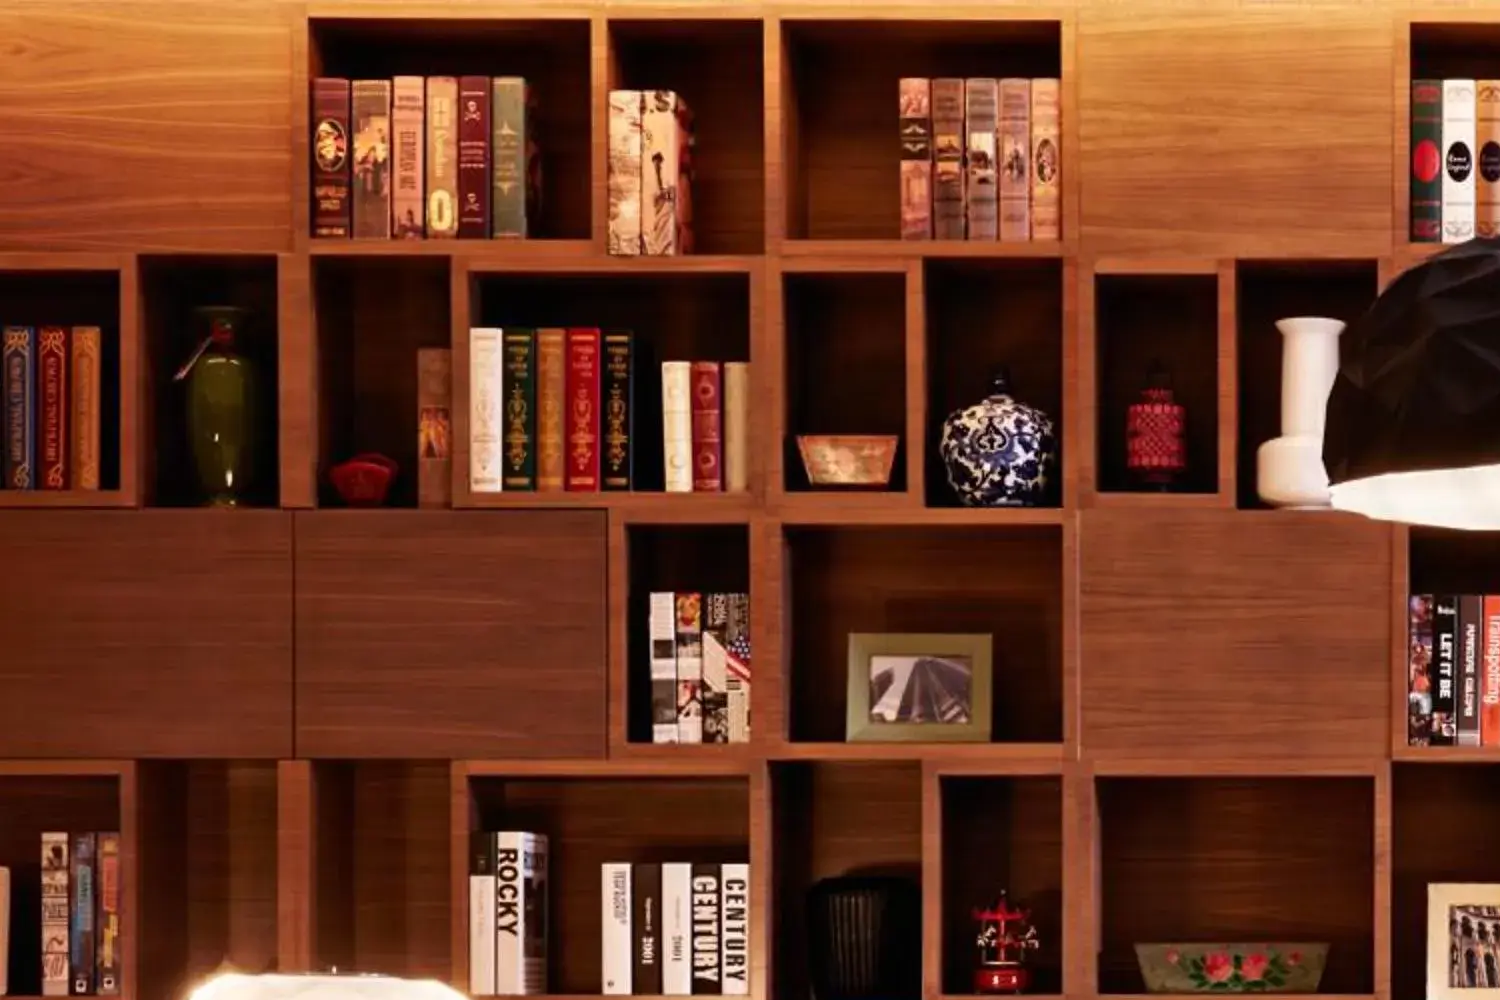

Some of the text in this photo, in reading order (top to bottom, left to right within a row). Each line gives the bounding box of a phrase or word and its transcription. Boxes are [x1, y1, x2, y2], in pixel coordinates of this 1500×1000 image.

[1439, 633, 1453, 698] LET IT BE
[499, 848, 518, 937] ROCKY
[693, 876, 718, 982] CENTURY
[725, 879, 746, 981] CENTURY
